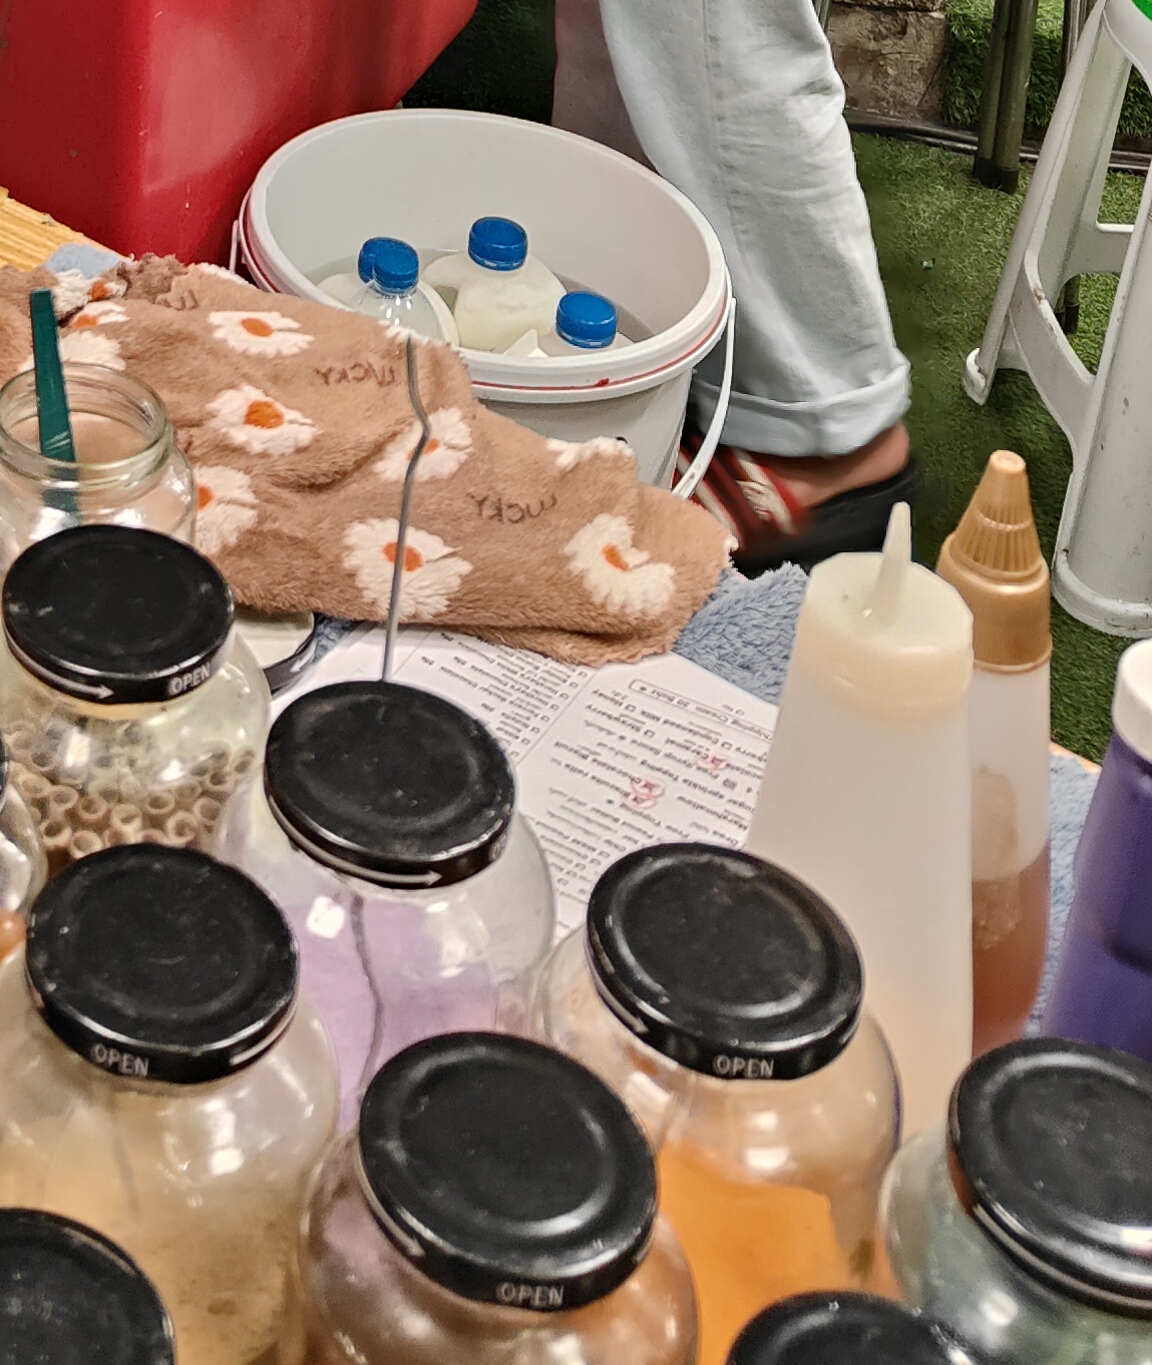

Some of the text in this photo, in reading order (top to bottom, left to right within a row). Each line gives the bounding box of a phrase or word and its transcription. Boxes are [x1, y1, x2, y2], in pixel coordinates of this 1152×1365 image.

[169, 662, 210, 695] OPEN
[440, 666, 477, 687] Chocolate
[470, 665, 507, 686] Chocolate
[592, 688, 622, 706] Honey
[651, 689, 674, 701] Baht
[677, 699, 688, 707] 20
[585, 703, 641, 731] Strawberry
[640, 710, 660, 721] Milk
[662, 719, 718, 743] Condensed
[630, 739, 661, 755] Sauce
[554, 741, 641, 783] Chocolate Biscuit
[640, 759, 679, 781] Topping
[591, 775, 630, 796] Biscuits
[620, 803, 660, 825] Topping
[92, 1043, 149, 1077] OPEN
[713, 1055, 774, 1078] OPEN
[496, 1282, 564, 1306] OPEN
